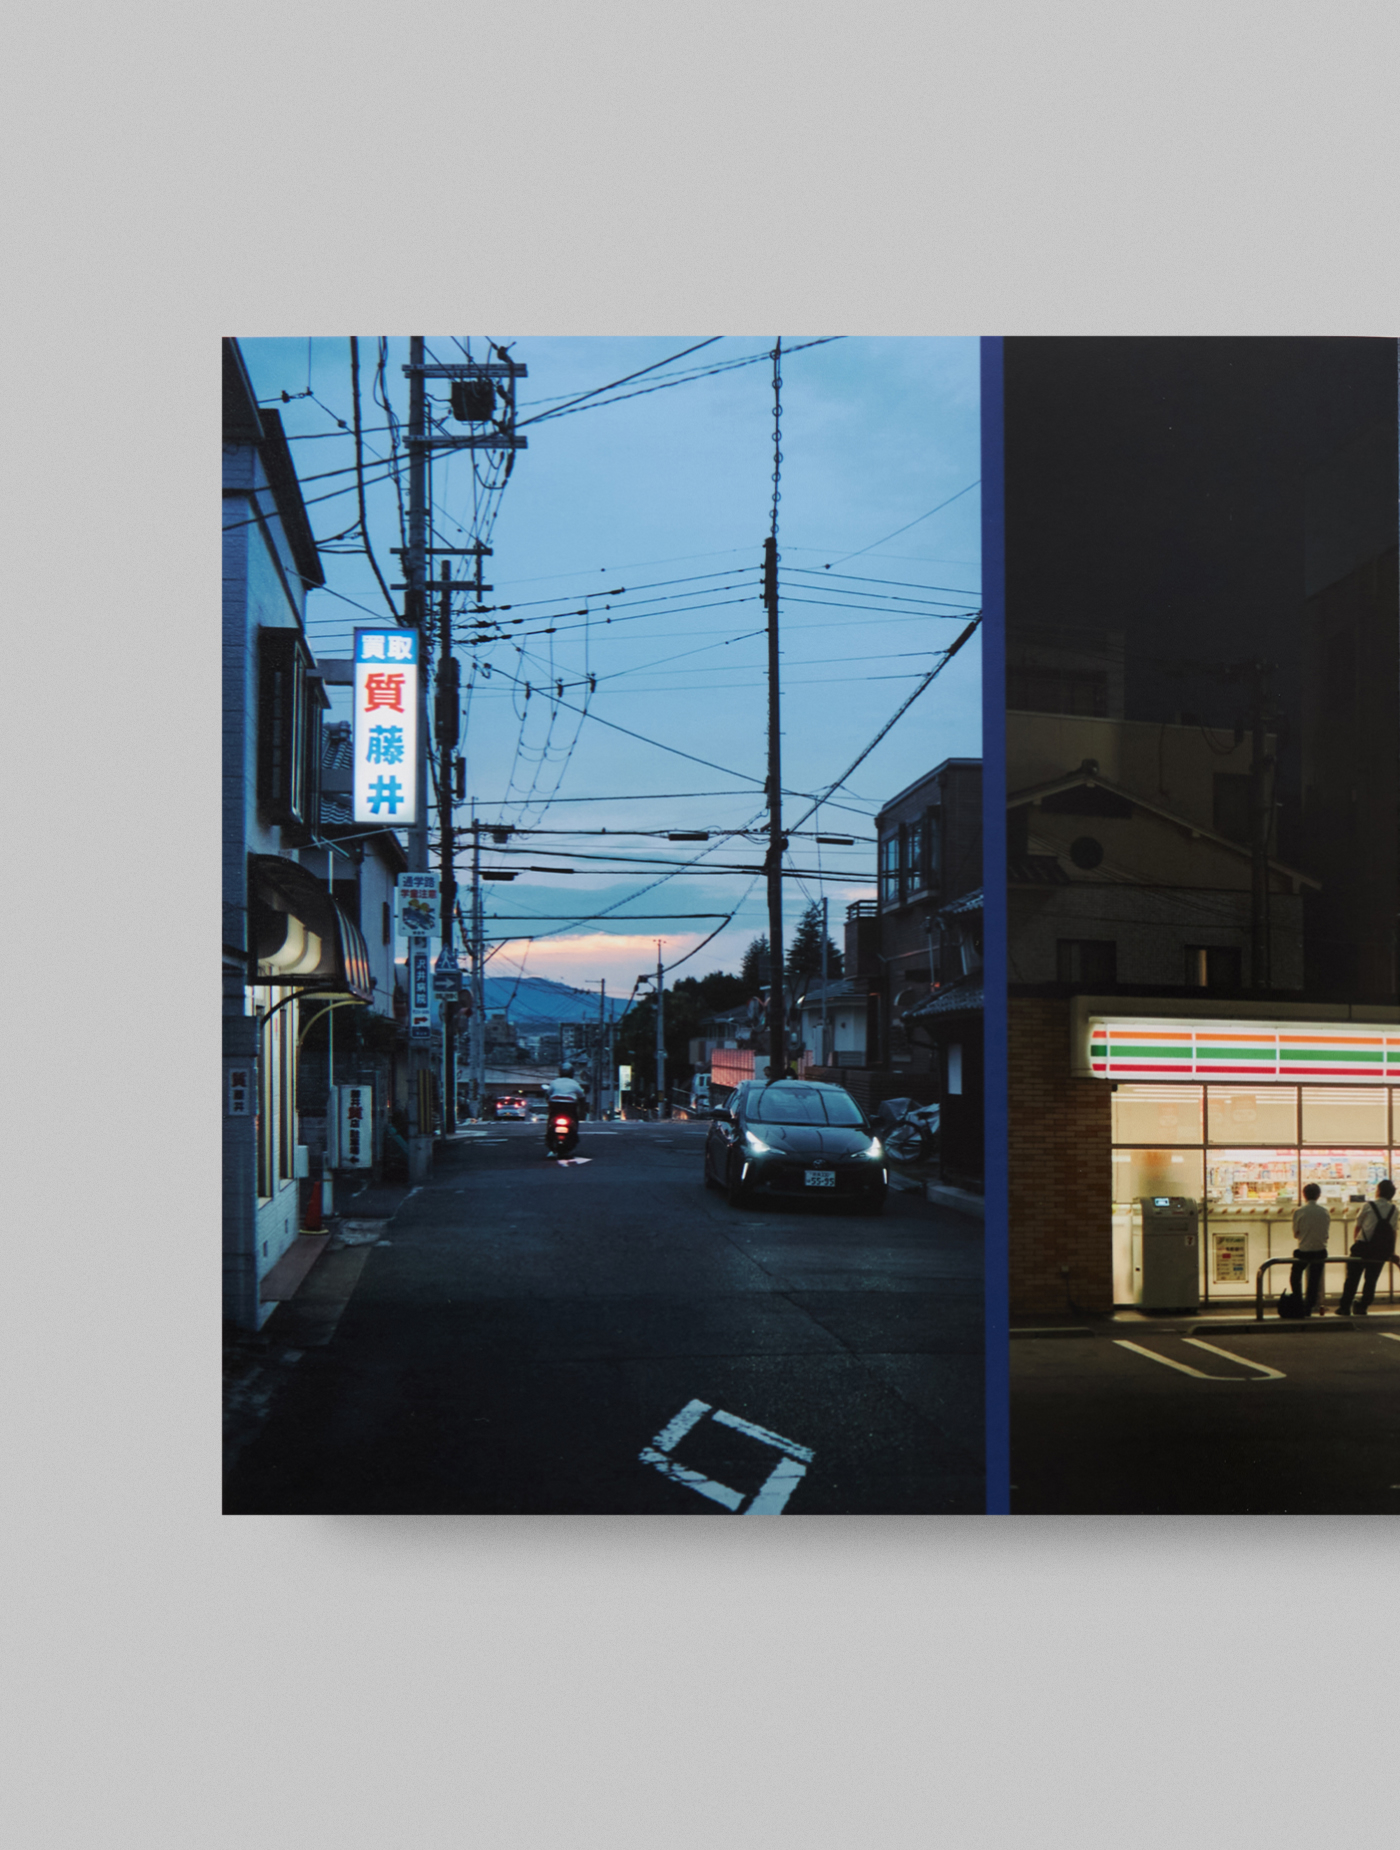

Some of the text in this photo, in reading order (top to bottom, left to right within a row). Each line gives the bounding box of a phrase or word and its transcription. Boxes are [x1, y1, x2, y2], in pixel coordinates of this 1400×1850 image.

[361, 635, 412, 660] 買取
[402, 876, 435, 888] 通学路
